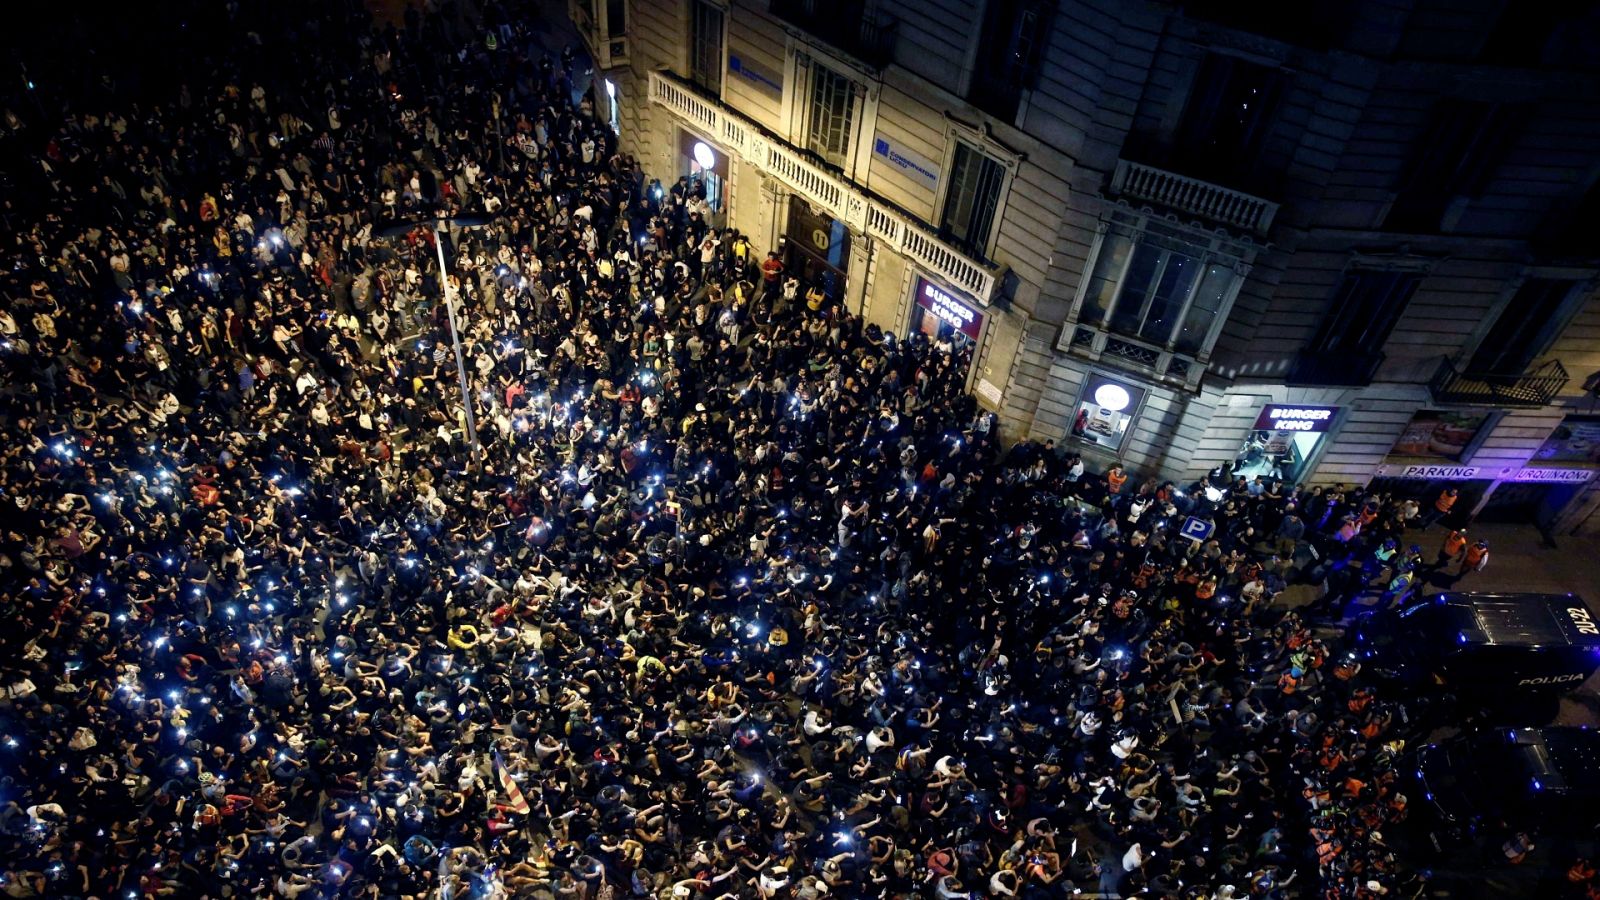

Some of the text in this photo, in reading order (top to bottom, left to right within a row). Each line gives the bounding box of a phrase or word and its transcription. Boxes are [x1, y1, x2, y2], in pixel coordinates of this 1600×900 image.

[815, 232, 826, 247] 11
[925, 284, 974, 323] BURGER
[931, 302, 963, 328] KING
[1269, 408, 1331, 420] BURGER
[1274, 419, 1314, 431] KING
[1406, 467, 1590, 479] PARKING URQUINAONA
[1187, 520, 1206, 533] P
[1566, 607, 1600, 635] 2U-22
[1518, 673, 1584, 686] POLICIA
